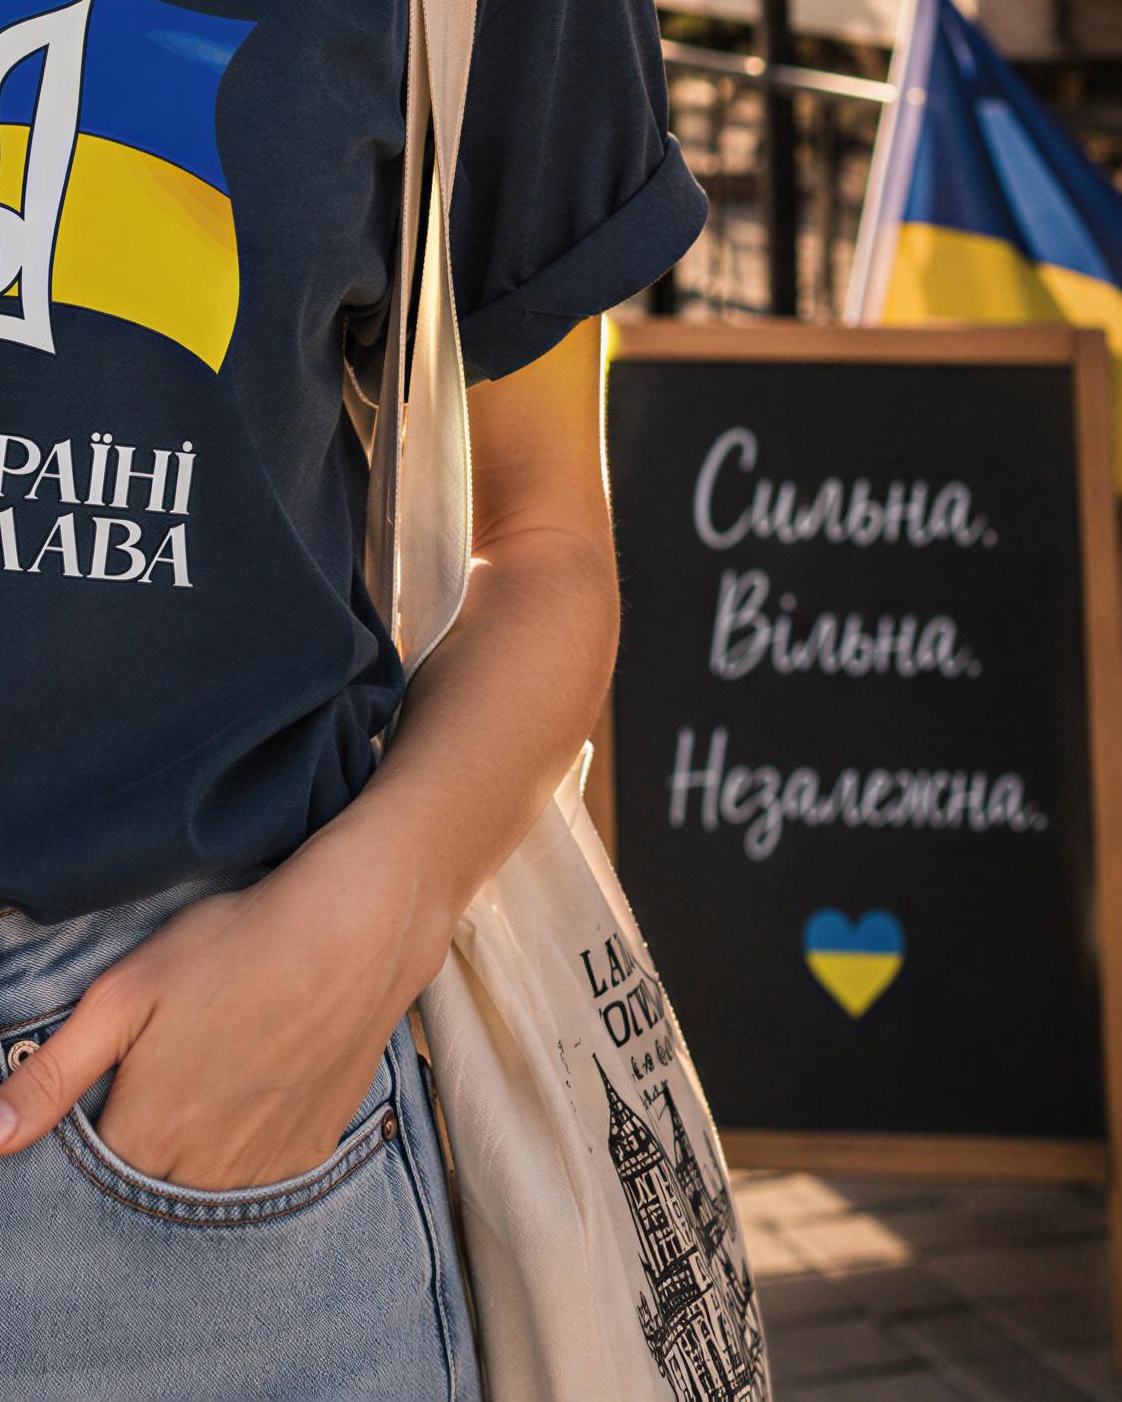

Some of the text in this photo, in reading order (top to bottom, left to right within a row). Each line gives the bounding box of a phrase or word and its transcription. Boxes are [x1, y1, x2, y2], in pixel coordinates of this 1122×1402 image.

[693, 427, 997, 549] Сильна.
[709, 569, 981, 679] Вільна.
[668, 727, 1047, 862] Незалежна.
